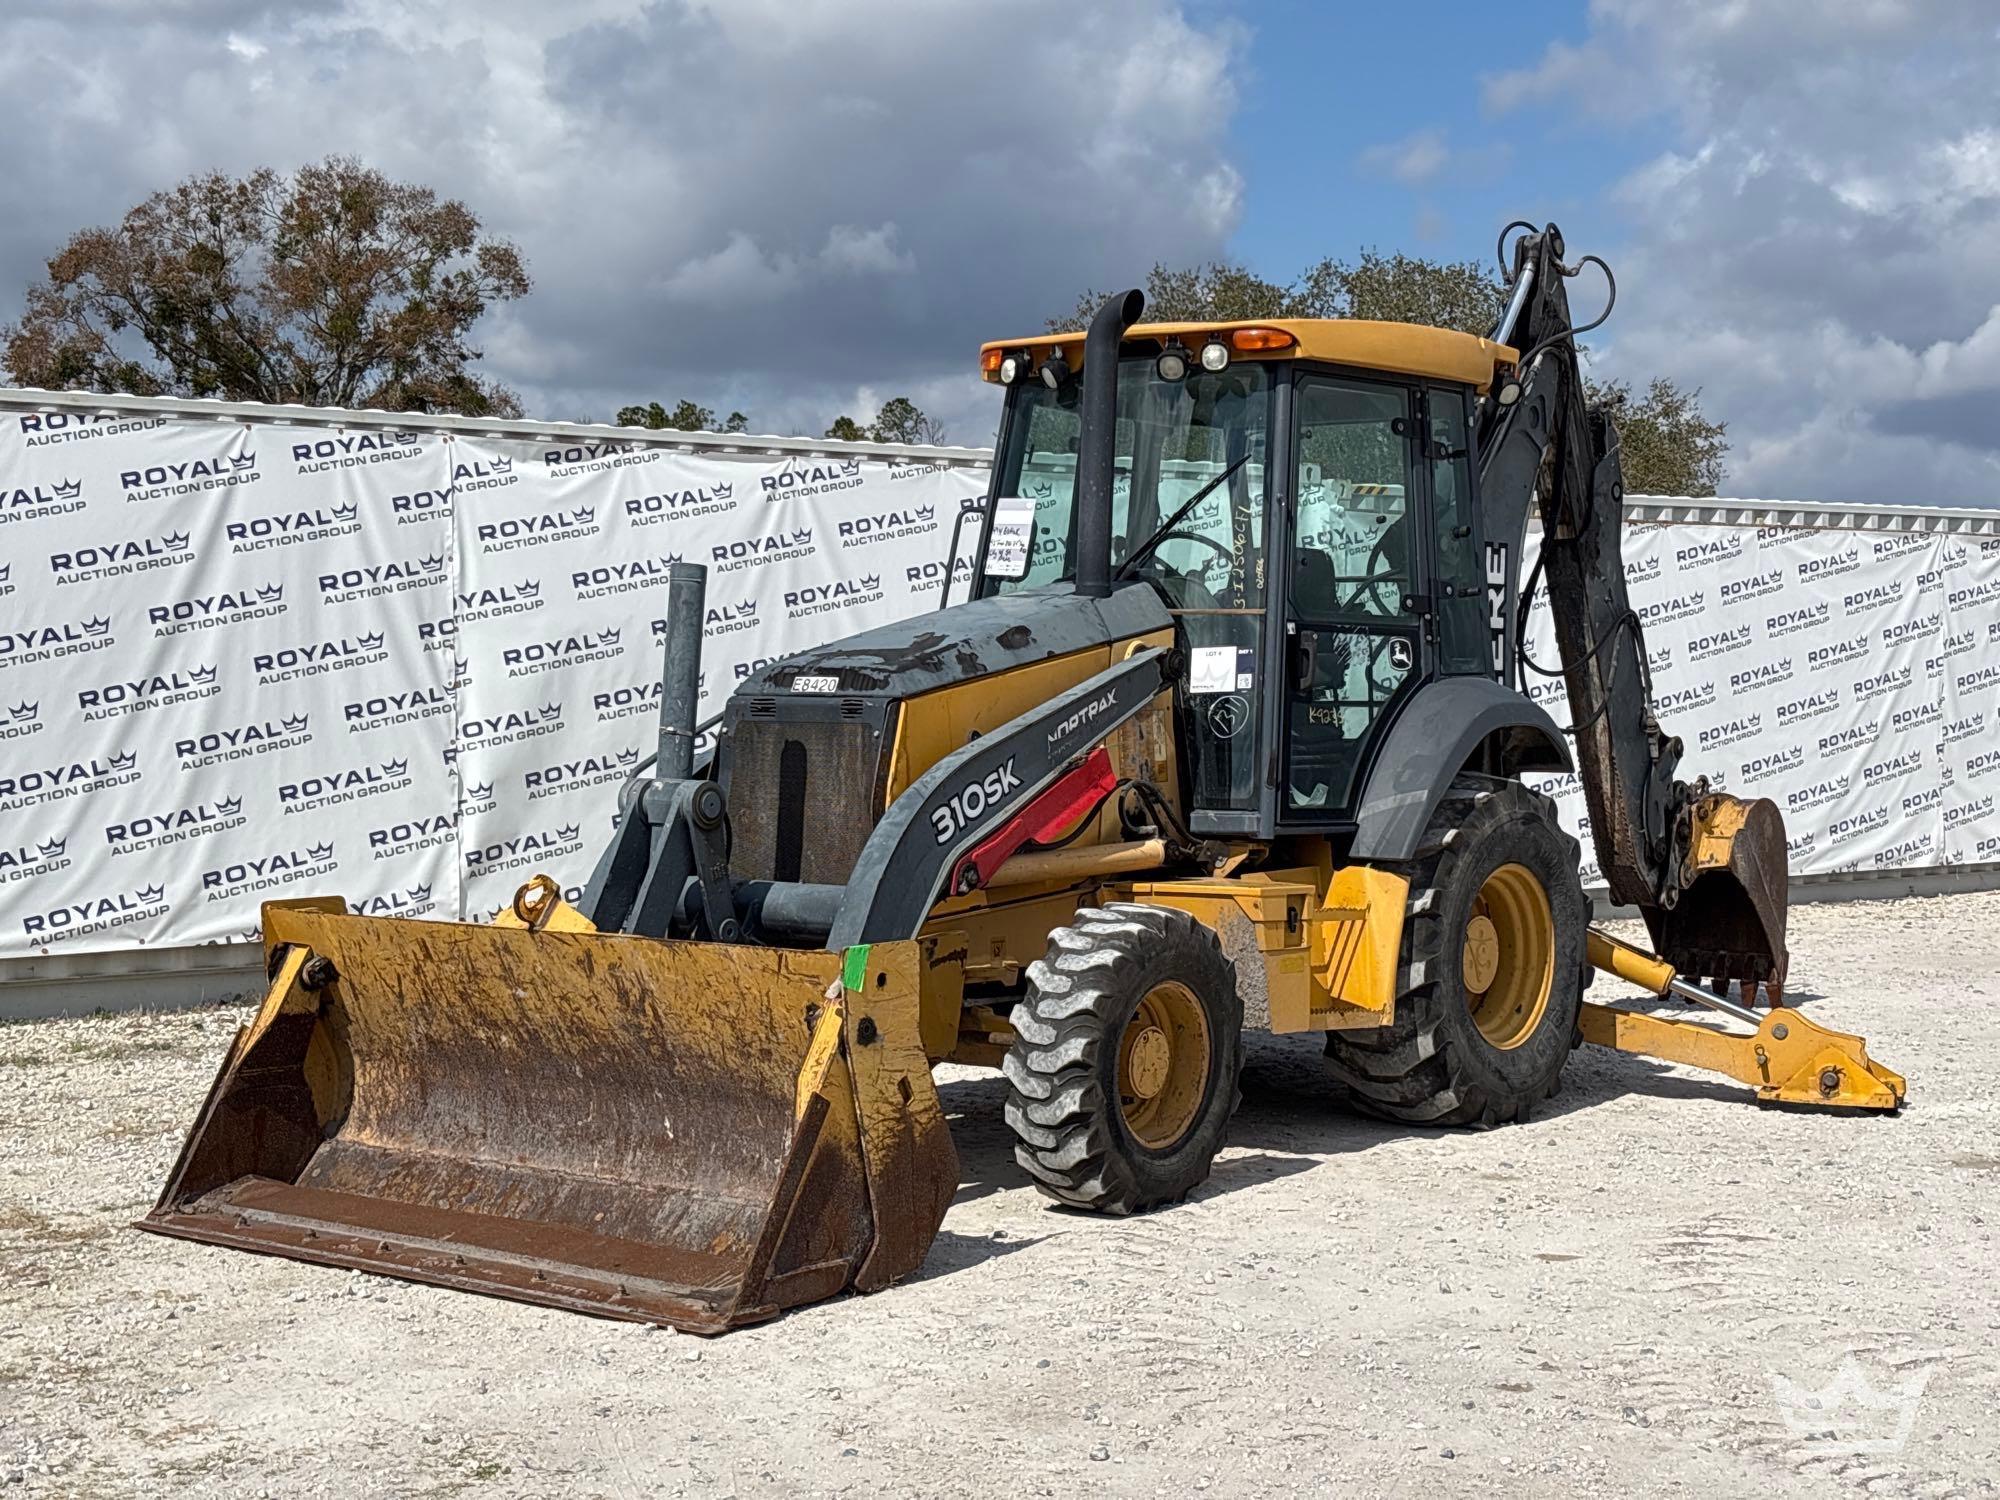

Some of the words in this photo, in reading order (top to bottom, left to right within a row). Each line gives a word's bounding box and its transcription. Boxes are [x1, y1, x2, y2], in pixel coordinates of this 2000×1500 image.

[26, 427, 104, 447] AUCTION
[106, 419, 166, 435] GROUP
[292, 436, 393, 461] ROYAL
[299, 456, 366, 472] AUCTION
[370, 448, 422, 461] GROUP
[120, 458, 229, 489] ROYAL
[760, 467, 840, 491] ROYAL
[127, 483, 200, 502] AUCTION
[204, 473, 260, 489] GROUP
[765, 486, 819, 501] AUCTION
[821, 479, 862, 491] GROUP
[26, 501, 86, 519] GROUP
[625, 488, 712, 515] ROYAL
[227, 510, 332, 540] ROYAL
[631, 510, 689, 527] AUCTION
[692, 502, 736, 516] GROUP
[838, 511, 915, 537] ROYAL
[233, 534, 304, 553] AUCTION
[307, 524, 361, 540] GROUP
[478, 513, 573, 541] ROYAL
[843, 531, 895, 548] AUCTION
[897, 523, 937, 537] GROUP
[484, 535, 548, 553] AUCTION
[551, 526, 599, 541] GROUP
[712, 534, 792, 561] ROYAL
[1677, 540, 1728, 562] ROYAL
[1875, 534, 1919, 555] ROYAL
[50, 539, 162, 572] ROYAL
[717, 556, 771, 573] AUCTION
[774, 547, 815, 561] GROUP
[1680, 557, 1714, 570] AUCTION
[1716, 549, 1742, 561] GROUP
[1799, 554, 1846, 575] ROYAL
[1876, 549, 1907, 563] AUCTION
[1908, 542, 1932, 554] GROUP
[57, 564, 132, 585] AUCTION
[136, 553, 194, 571] GROUP
[319, 561, 420, 592] ROYAL
[572, 560, 661, 588] ROYAL
[1802, 570, 1834, 583] AUCTION
[1835, 563, 1860, 574] GROUP
[325, 585, 393, 604] AUCTION
[396, 575, 448, 591] GROUP
[578, 582, 637, 600] AUCTION
[783, 580, 861, 607] ROYAL
[1721, 575, 1769, 597] ROYAL
[1723, 592, 1756, 605] AUCTION
[1758, 584, 1782, 595] GROUP
[1845, 586, 1890, 607] ROYAL
[1949, 584, 1991, 604] ROYAL
[148, 591, 256, 624] ROYAL
[788, 601, 840, 619] AUCTION
[843, 592, 882, 607] GROUP
[1639, 598, 1691, 619] ROYAL
[1847, 602, 1877, 615] AUCTION
[1879, 594, 1902, 606] GROUP
[1951, 599, 1979, 612] AUCTION
[154, 616, 227, 637] AUCTION
[231, 605, 286, 622] GROUP
[1642, 613, 1677, 629] AUCTION
[1678, 606, 1706, 618] GROUP
[1767, 608, 1816, 629] ROYAL
[1769, 624, 1802, 638] AUCTION
[1804, 616, 1829, 628] GROUP
[1884, 619, 1928, 640] ROYAL
[54, 638, 115, 658] GROUP
[1689, 630, 1738, 653] ROYAL
[1886, 634, 1916, 648] AUCTION
[1918, 627, 1940, 638] GROUP
[253, 639, 358, 672] ROYAL
[504, 635, 597, 666] ROYAL
[1691, 647, 1724, 661] AUCTION
[1726, 639, 1751, 651] GROUP
[1809, 641, 1856, 663] ROYAL
[1811, 657, 1843, 671] AUCTION
[1845, 649, 1869, 661] GROUP
[259, 664, 329, 685] AUCTION
[333, 652, 387, 670] GROUP
[509, 658, 572, 678] AUCTION
[575, 647, 623, 664] GROUP
[792, 678, 837, 691] E8420
[1731, 664, 1779, 686] ROYAL
[1733, 680, 1766, 695] AUCTION
[1768, 672, 1792, 684] GROUP
[1855, 672, 1900, 694] ROYAL
[78, 673, 189, 709] ROYAL
[1857, 687, 1887, 702] AUCTION
[1889, 679, 1912, 691] GROUP
[84, 699, 159, 722] AUCTION
[163, 686, 220, 705] GROUP
[345, 688, 444, 721] ROYAL
[1778, 695, 1826, 718] ROYAL
[1780, 711, 1812, 726] AUCTION
[1814, 703, 1839, 715] GROUP
[1894, 703, 1937, 725] ROYAL
[350, 711, 417, 733] AUCTION
[1700, 719, 1748, 743] ROYAL
[1895, 719, 1924, 733] AUCTION
[175, 722, 282, 758] ROYAL
[1702, 736, 1735, 752] AUCTION
[1737, 728, 1762, 740] GROUP
[1819, 727, 1866, 750] ROYAL
[1822, 743, 1853, 758] AUCTION
[1855, 734, 1879, 746] GROUP
[181, 747, 253, 770] AUCTION
[257, 734, 311, 754] GROUP
[1742, 752, 1790, 775] ROYAL
[0, 760, 109, 797] ROYAL
[525, 756, 615, 788] ROYAL
[1744, 768, 1777, 784] AUCTION
[1779, 760, 1803, 772] GROUP
[1865, 756, 1909, 779] ROYAL
[1866, 772, 1897, 787] AUCTION
[1898, 764, 1921, 776] GROUP
[0, 786, 78, 812] AUCTION
[82, 772, 142, 793] GROUP
[278, 767, 382, 802] ROYAL
[284, 792, 354, 815] AUCTION
[358, 778, 410, 798] GROUP
[528, 778, 590, 800] AUCTION
[1788, 782, 1836, 805] ROYAL
[931, 757, 1022, 844] 310SK
[1791, 798, 1824, 813] AUCTION
[1825, 789, 1850, 802] GROUP
[106, 806, 215, 843] ROYAL
[1830, 812, 1876, 836] ROYAL
[1832, 828, 1864, 844] AUCTION
[1865, 819, 1889, 832] GROUP
[112, 831, 186, 856] AUCTION
[190, 817, 246, 837] GROUP
[464, 832, 556, 867] ROYAL
[469, 856, 531, 878] AUCTION
[534, 842, 582, 861] GROUP
[10, 858, 71, 881] GROUP
[202, 851, 307, 889] ROYAL
[208, 877, 279, 902] AUCTION
[282, 862, 337, 882] GROUP
[23, 894, 137, 935] ROYAL
[30, 921, 107, 948] AUCTION
[111, 905, 169, 927] GROUP
